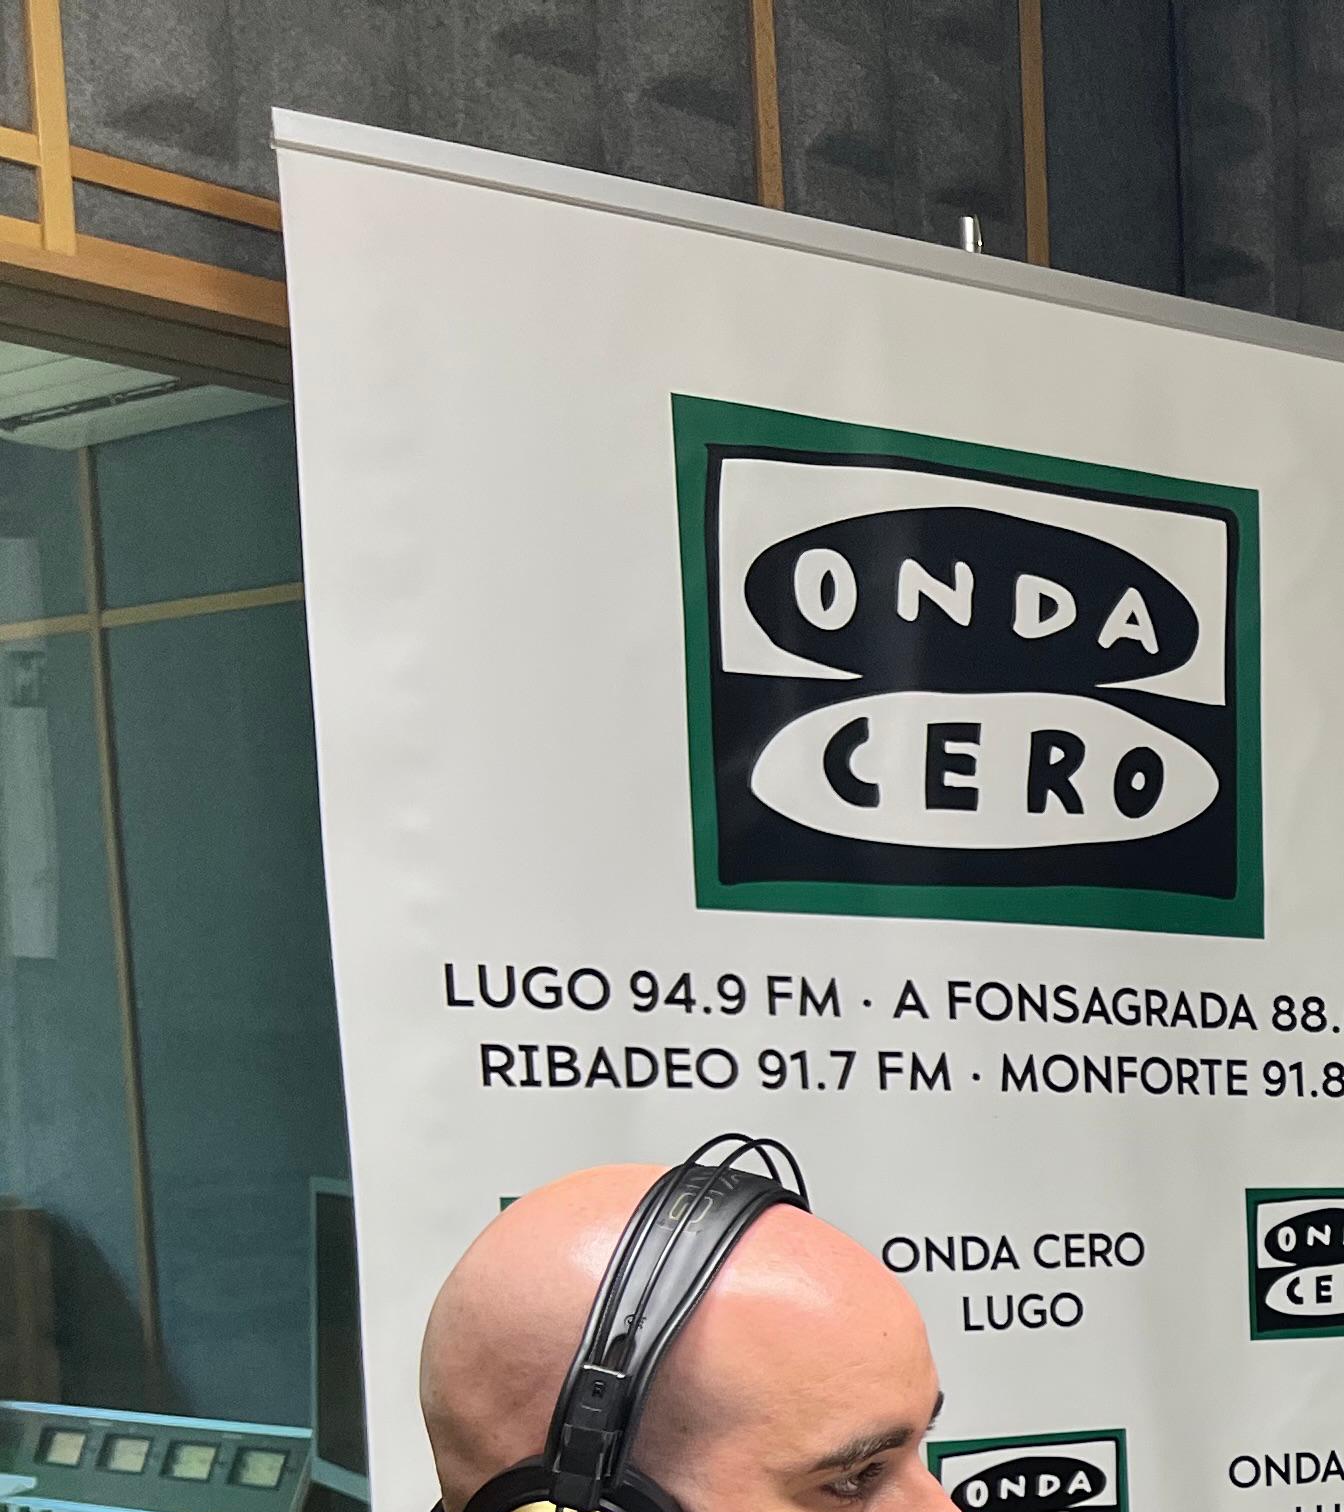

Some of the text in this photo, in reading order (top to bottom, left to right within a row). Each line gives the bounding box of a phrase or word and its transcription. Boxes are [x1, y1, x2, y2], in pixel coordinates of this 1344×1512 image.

[793, 547, 1162, 656] ONDA
[822, 716, 1166, 820] CERO
[445, 964, 610, 1011] LUGO
[629, 970, 746, 1015] 94.9
[766, 975, 841, 1018] FM
[892, 979, 930, 1019] A
[947, 980, 1258, 1031] FONSAGRADA
[480, 1043, 739, 1090] RIBADEO
[757, 1048, 857, 1091] 91.7
[877, 1050, 952, 1092] FM
[1001, 1053, 1248, 1096] MONFORTE
[882, 1231, 1145, 1273] ONDA CERO
[962, 1292, 1084, 1332] LUGO
[965, 1473, 1092, 1509] ONDA
